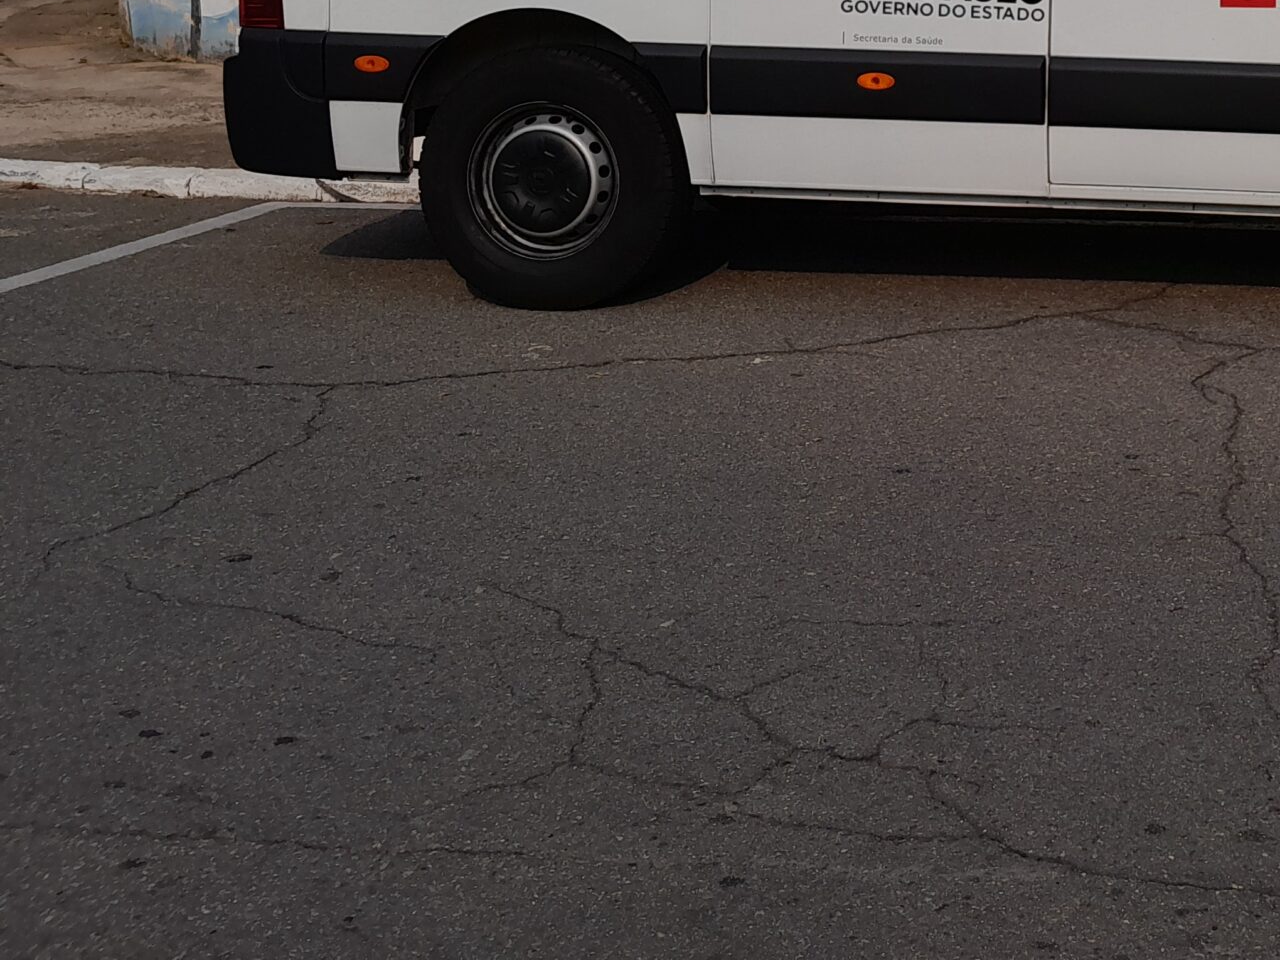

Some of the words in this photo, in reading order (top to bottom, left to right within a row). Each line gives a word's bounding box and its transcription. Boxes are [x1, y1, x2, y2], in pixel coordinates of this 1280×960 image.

[840, 0, 934, 17] GOVERNO
[938, 3, 966, 18] DO
[971, 5, 1045, 22] ESTADO
[853, 33, 899, 44] Secretaria
[901, 35, 913, 44] da
[916, 35, 944, 46] Saúde
